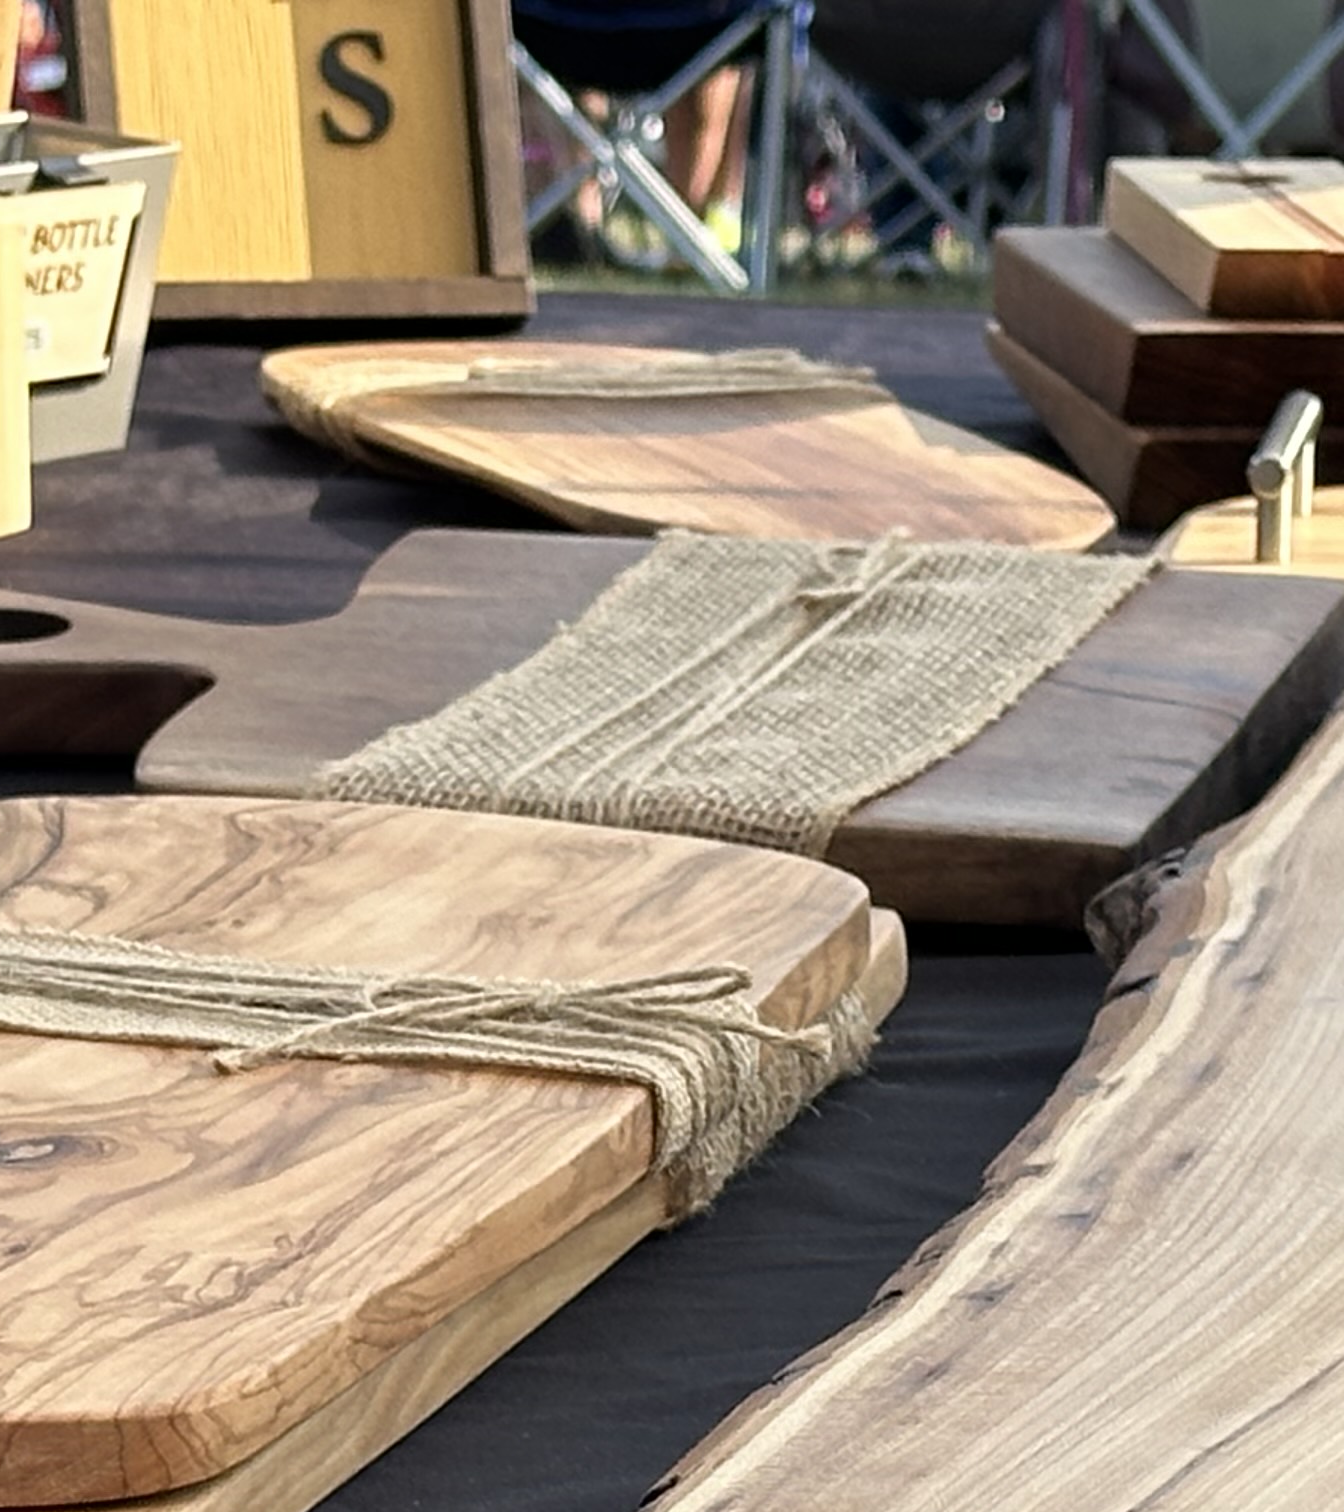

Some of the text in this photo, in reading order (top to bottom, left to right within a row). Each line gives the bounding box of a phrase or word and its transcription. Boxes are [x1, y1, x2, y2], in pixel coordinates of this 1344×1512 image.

[320, 31, 393, 146] S
[29, 214, 120, 255] BOTTLE
[22, 262, 86, 294] NERS
